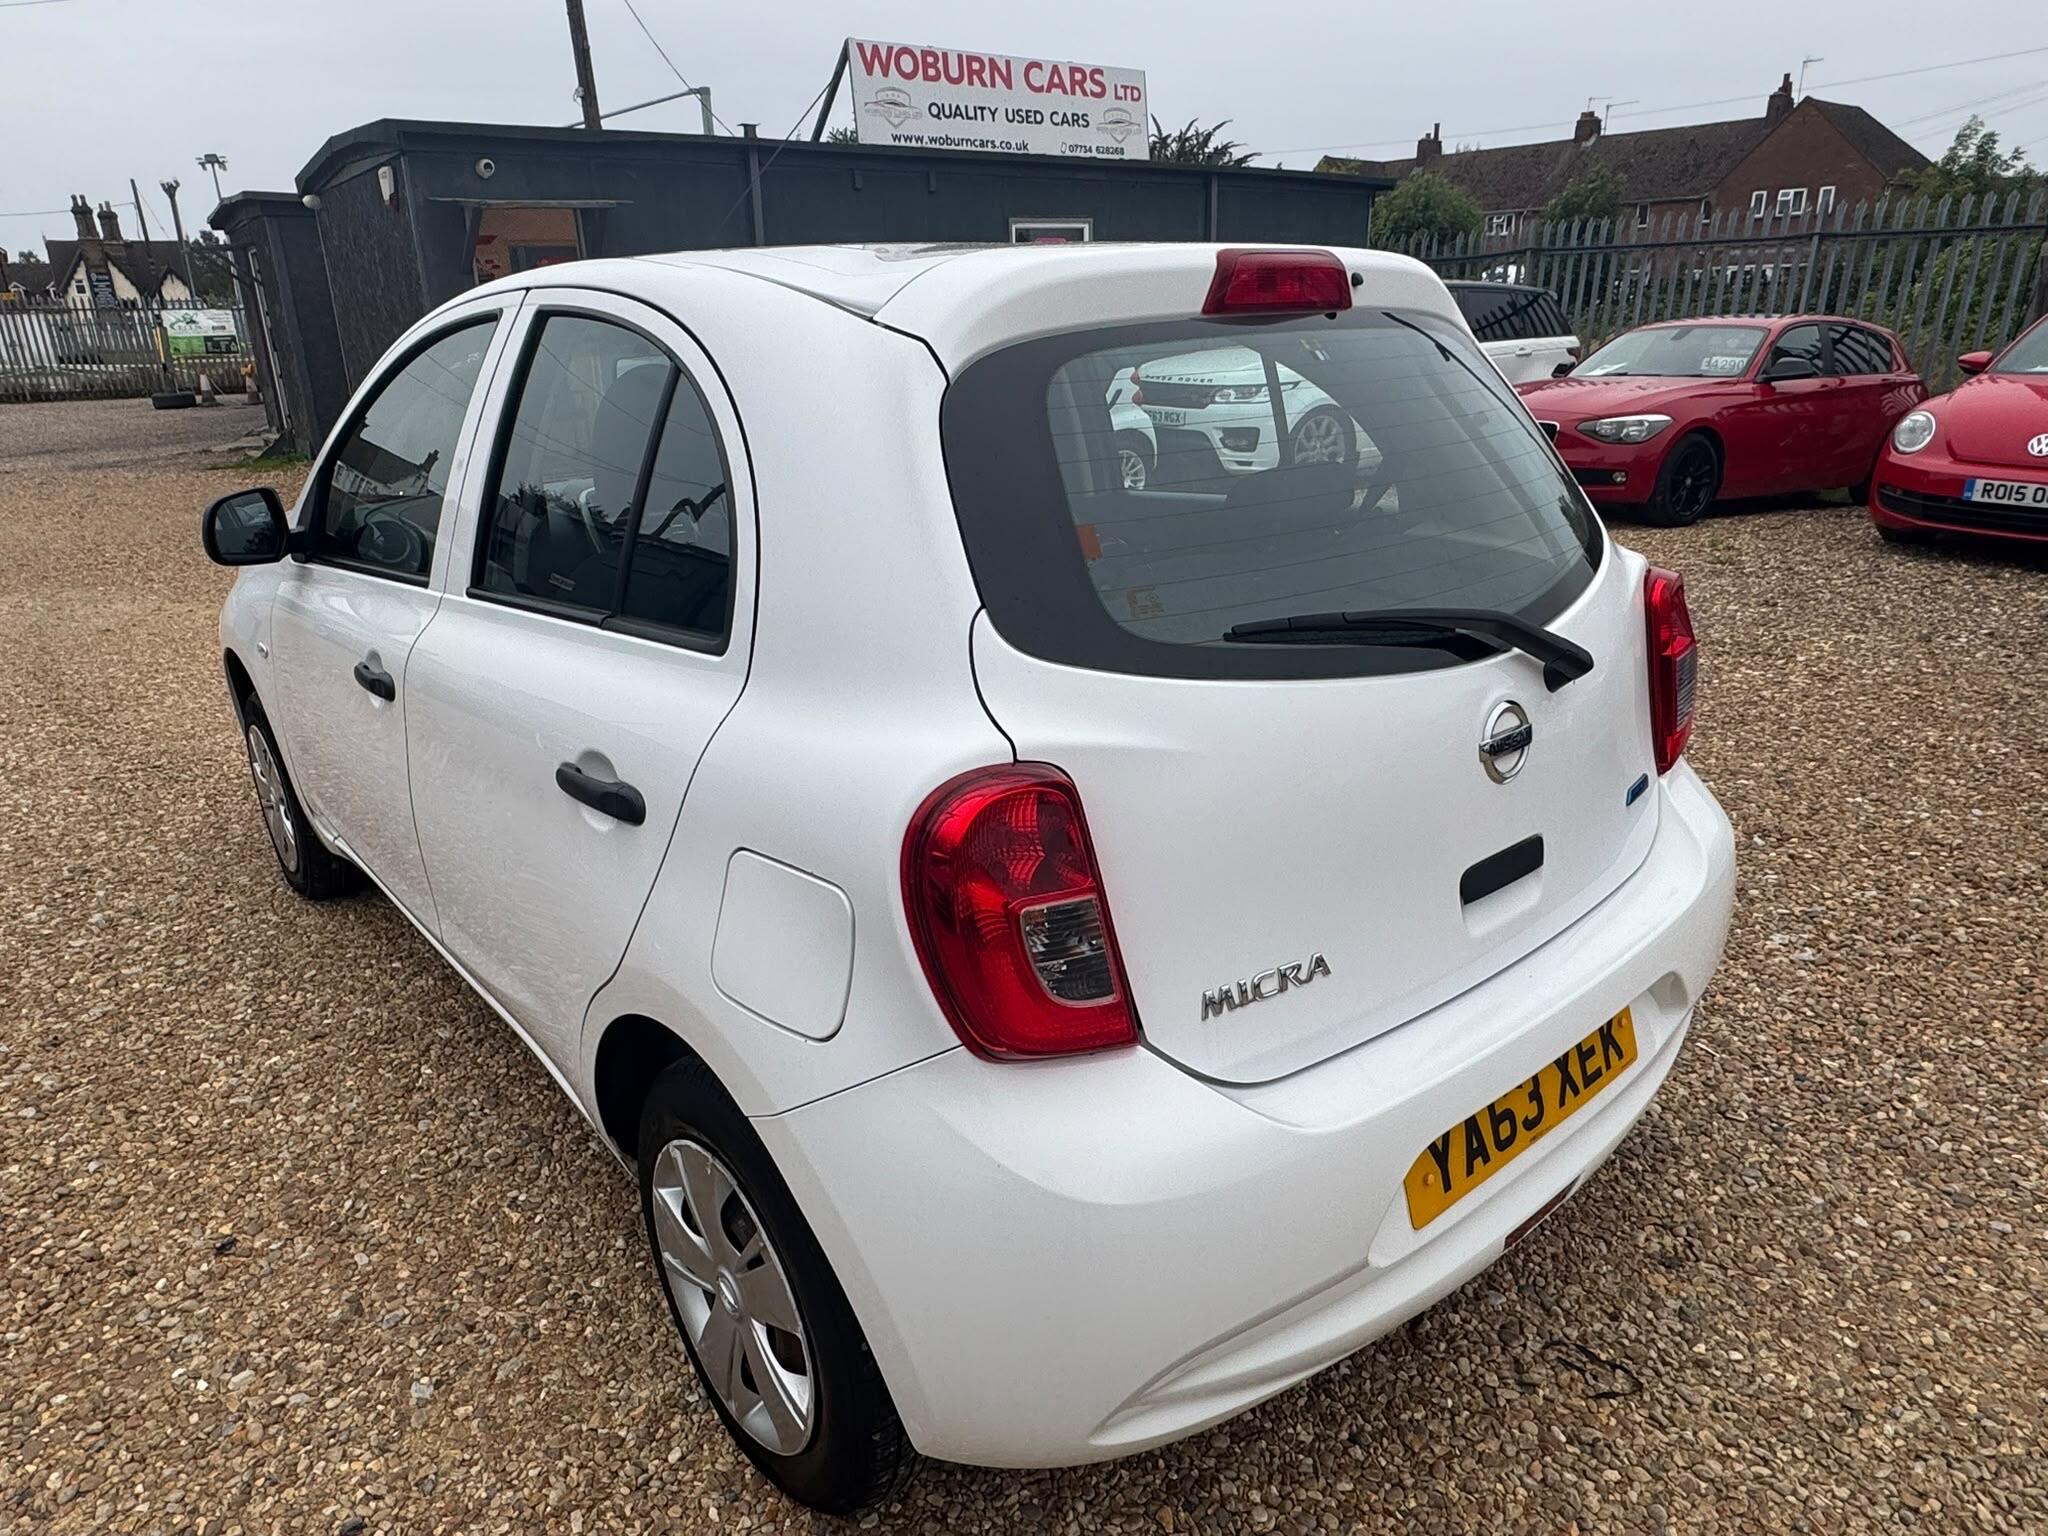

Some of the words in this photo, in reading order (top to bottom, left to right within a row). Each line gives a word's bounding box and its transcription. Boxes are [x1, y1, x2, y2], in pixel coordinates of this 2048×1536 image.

[856, 42, 1013, 91] WOBURN
[1023, 61, 1107, 99] CARS
[1114, 83, 1142, 102] LTD
[927, 101, 998, 122] QUALITY
[1005, 107, 1044, 125] USED
[1049, 110, 1090, 128] CARS
[891, 133, 1029, 152] www.woburncars.co.uk
[1068, 144, 1093, 154] 07734
[1980, 482, 2028, 502] RO15
[1201, 952, 1331, 1021] MICRA
[1427, 1073, 1545, 1194] YA63
[1553, 1018, 1624, 1109] XEK
